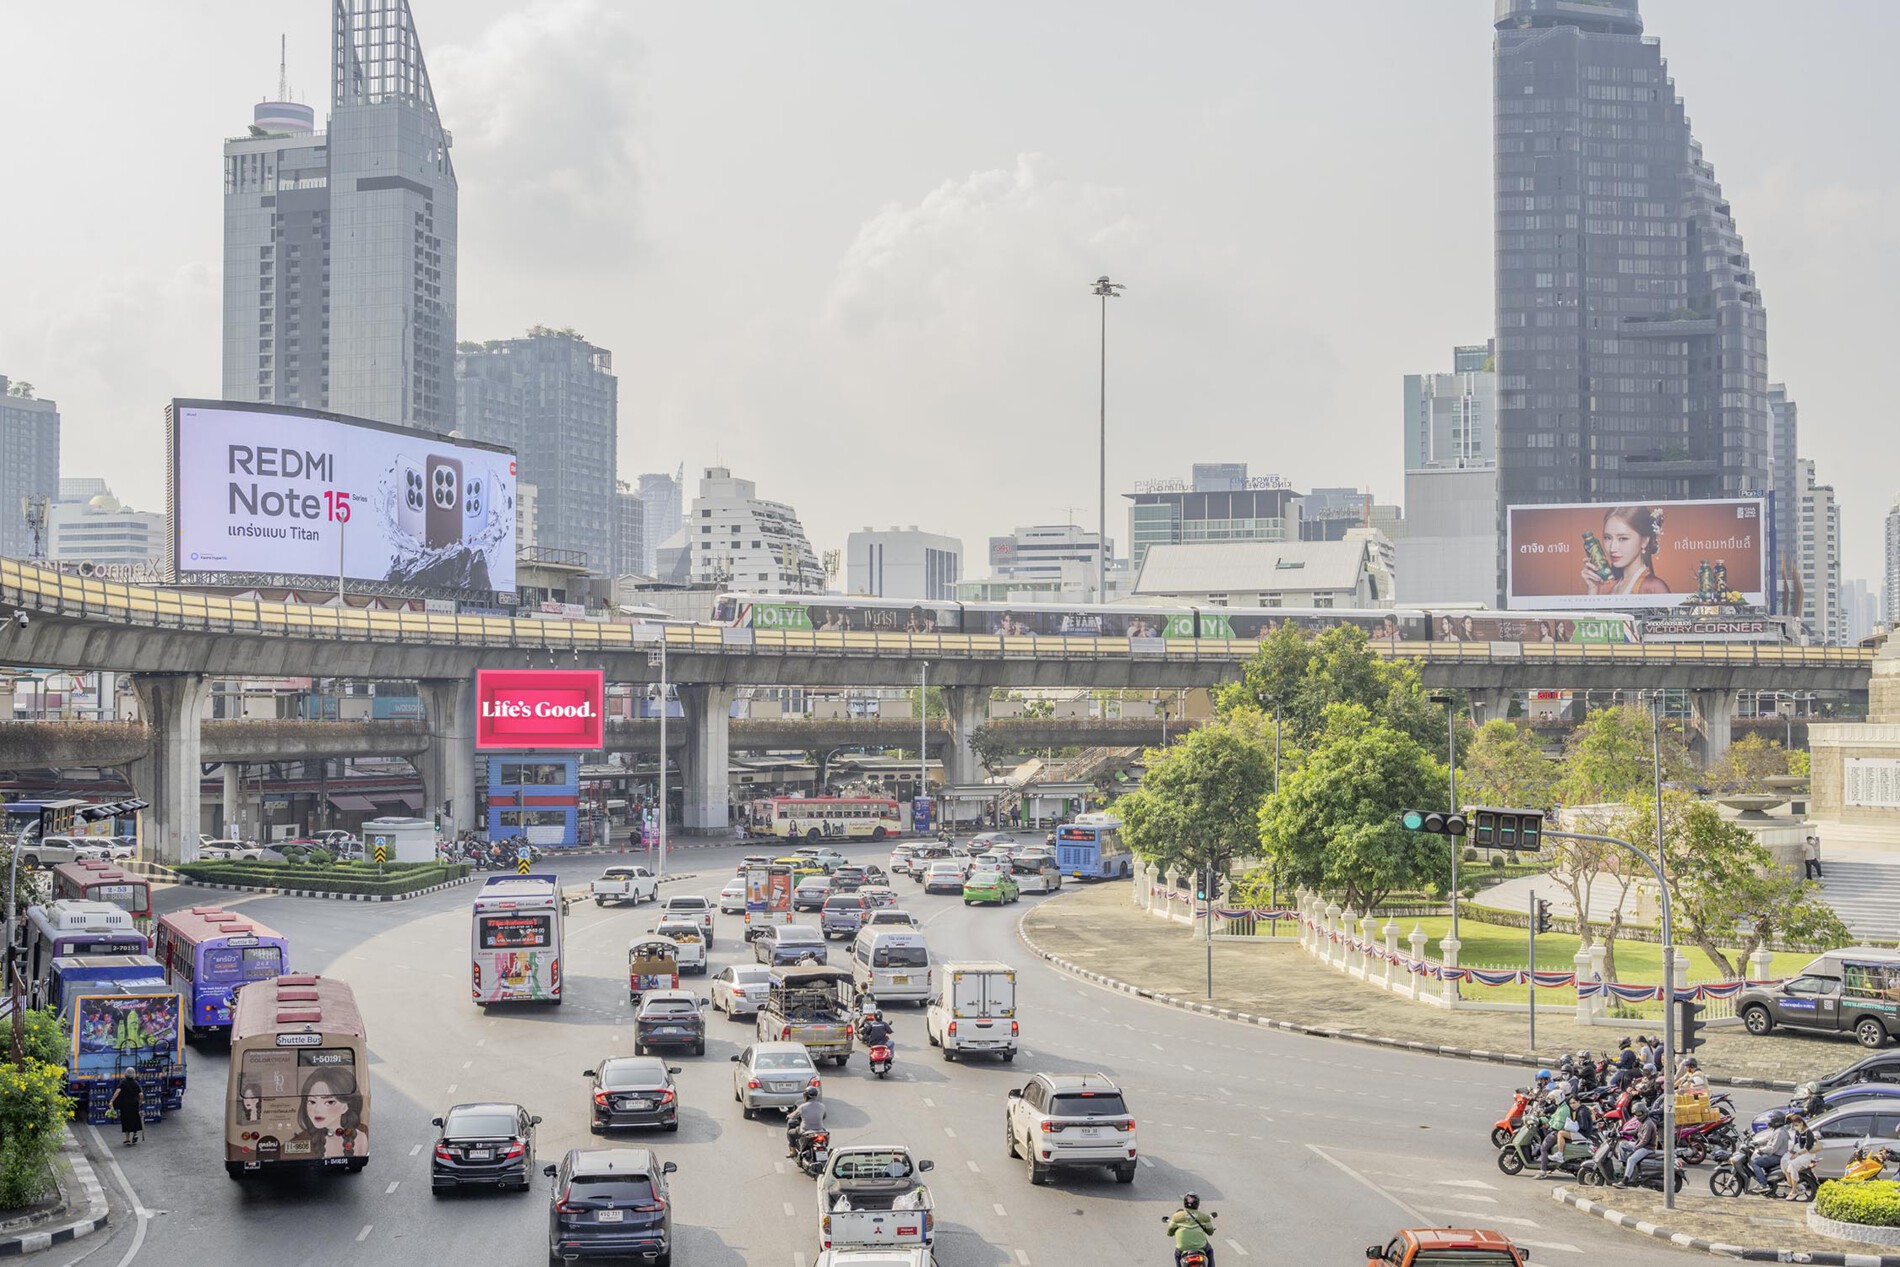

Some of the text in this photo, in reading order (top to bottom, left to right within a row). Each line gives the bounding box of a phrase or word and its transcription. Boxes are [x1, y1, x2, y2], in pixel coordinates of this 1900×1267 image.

[228, 444, 334, 483] REDMI
[229, 482, 368, 524] Note 15 Series
[228, 523, 320, 541] แกร่งแบบ Titan
[78, 555, 160, 578] ConneX
[1694, 622, 1763, 633] CORNER
[534, 701, 597, 718] Good.
[277, 1036, 306, 1044] Shuttle
[312, 1055, 342, 1063] 1-50191
